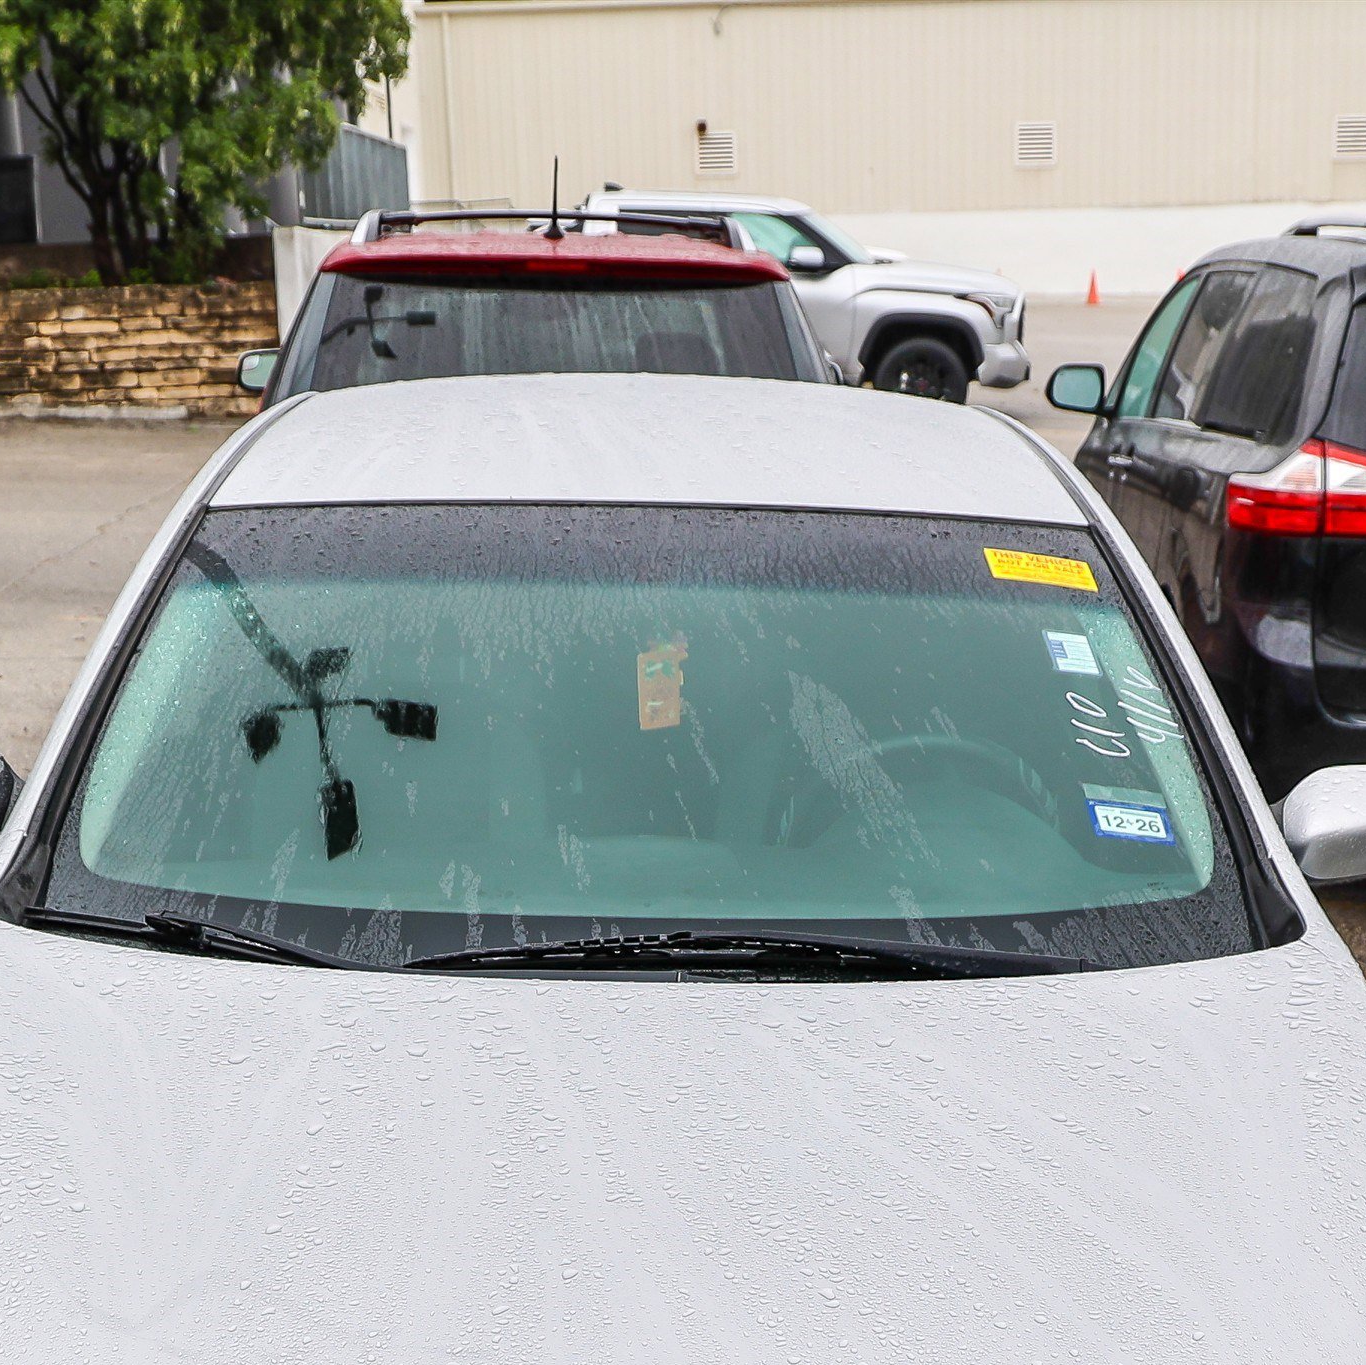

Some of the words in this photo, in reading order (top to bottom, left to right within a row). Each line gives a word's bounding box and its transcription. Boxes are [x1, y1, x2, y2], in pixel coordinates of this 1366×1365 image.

[992, 550, 1023, 561] THIS
[1026, 554, 1085, 570] VEHICLE
[997, 558, 1021, 567] NOT
